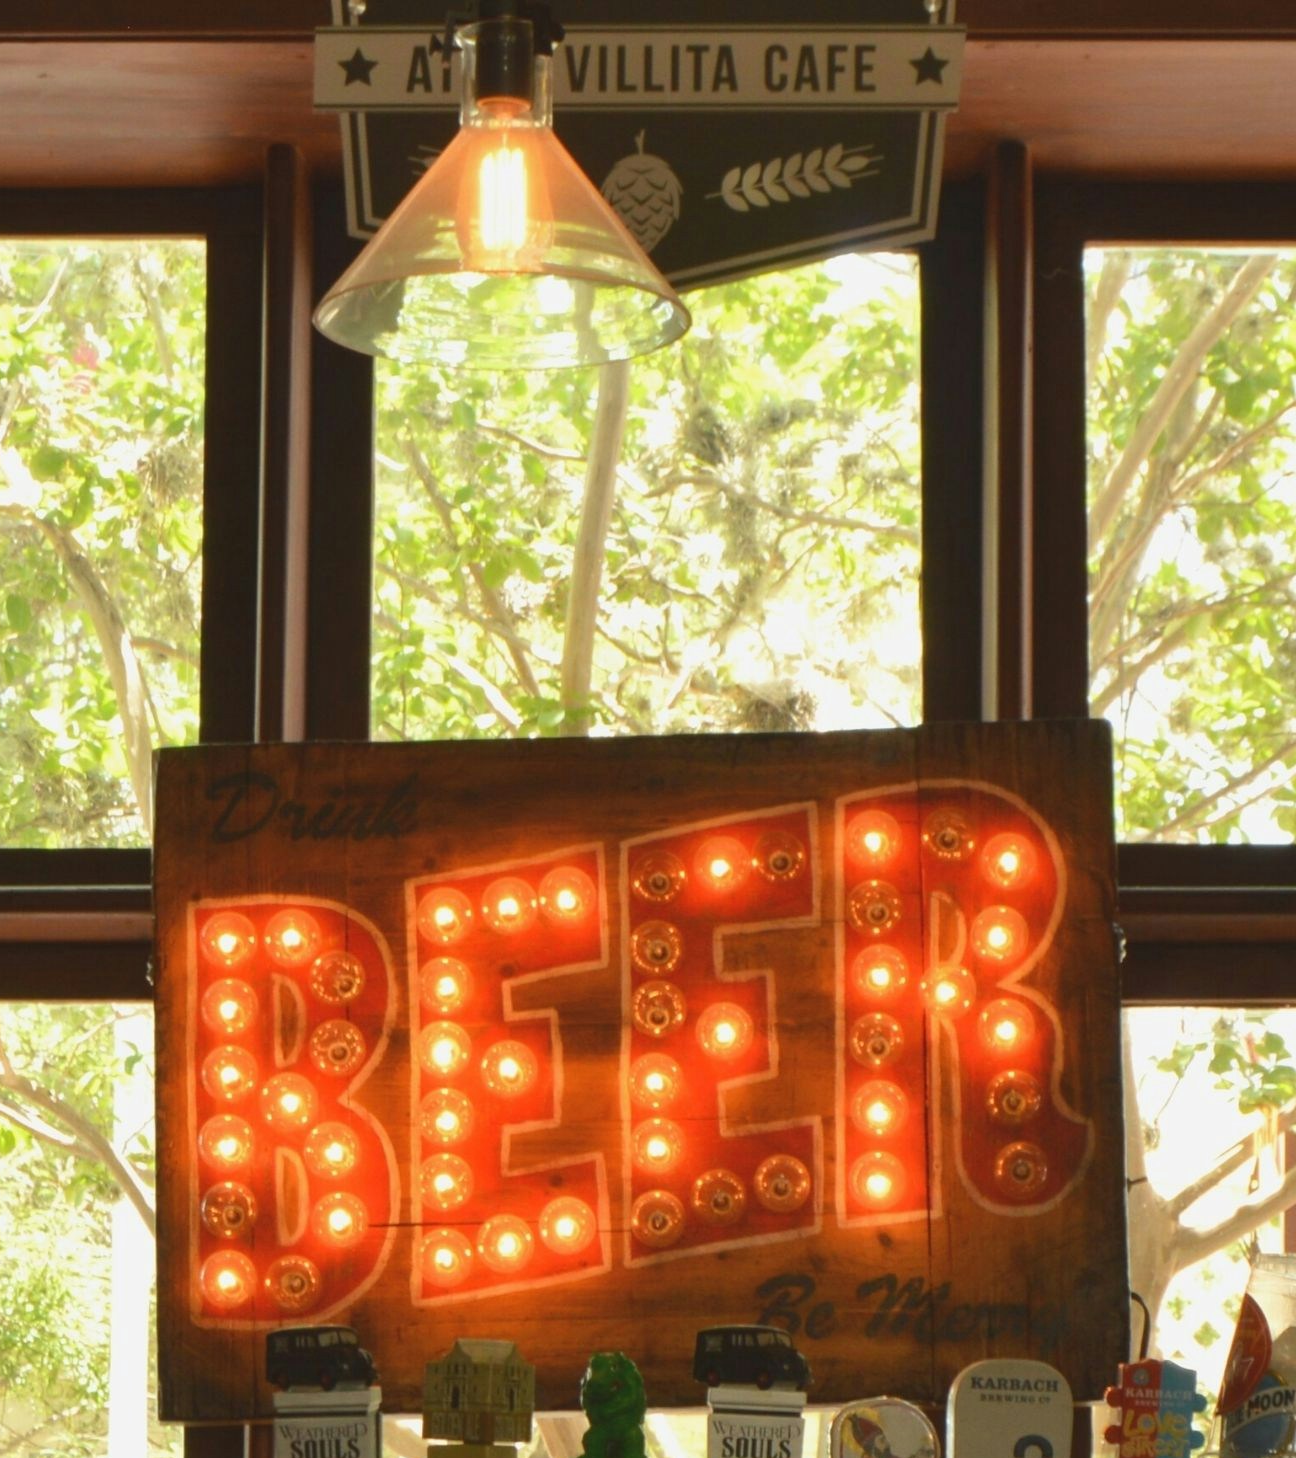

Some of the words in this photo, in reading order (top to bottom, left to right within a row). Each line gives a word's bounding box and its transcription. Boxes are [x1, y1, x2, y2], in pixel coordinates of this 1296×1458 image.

[564, 45, 739, 94] VILLITA
[763, 45, 878, 94] CAFE
[187, 778, 1096, 1330] BEER
[970, 1376, 1059, 1392] KARBACH
[980, 1394, 1035, 1404] BREWING
[1247, 1389, 1296, 1419] MOON
[1123, 1409, 1188, 1438] LOVE
